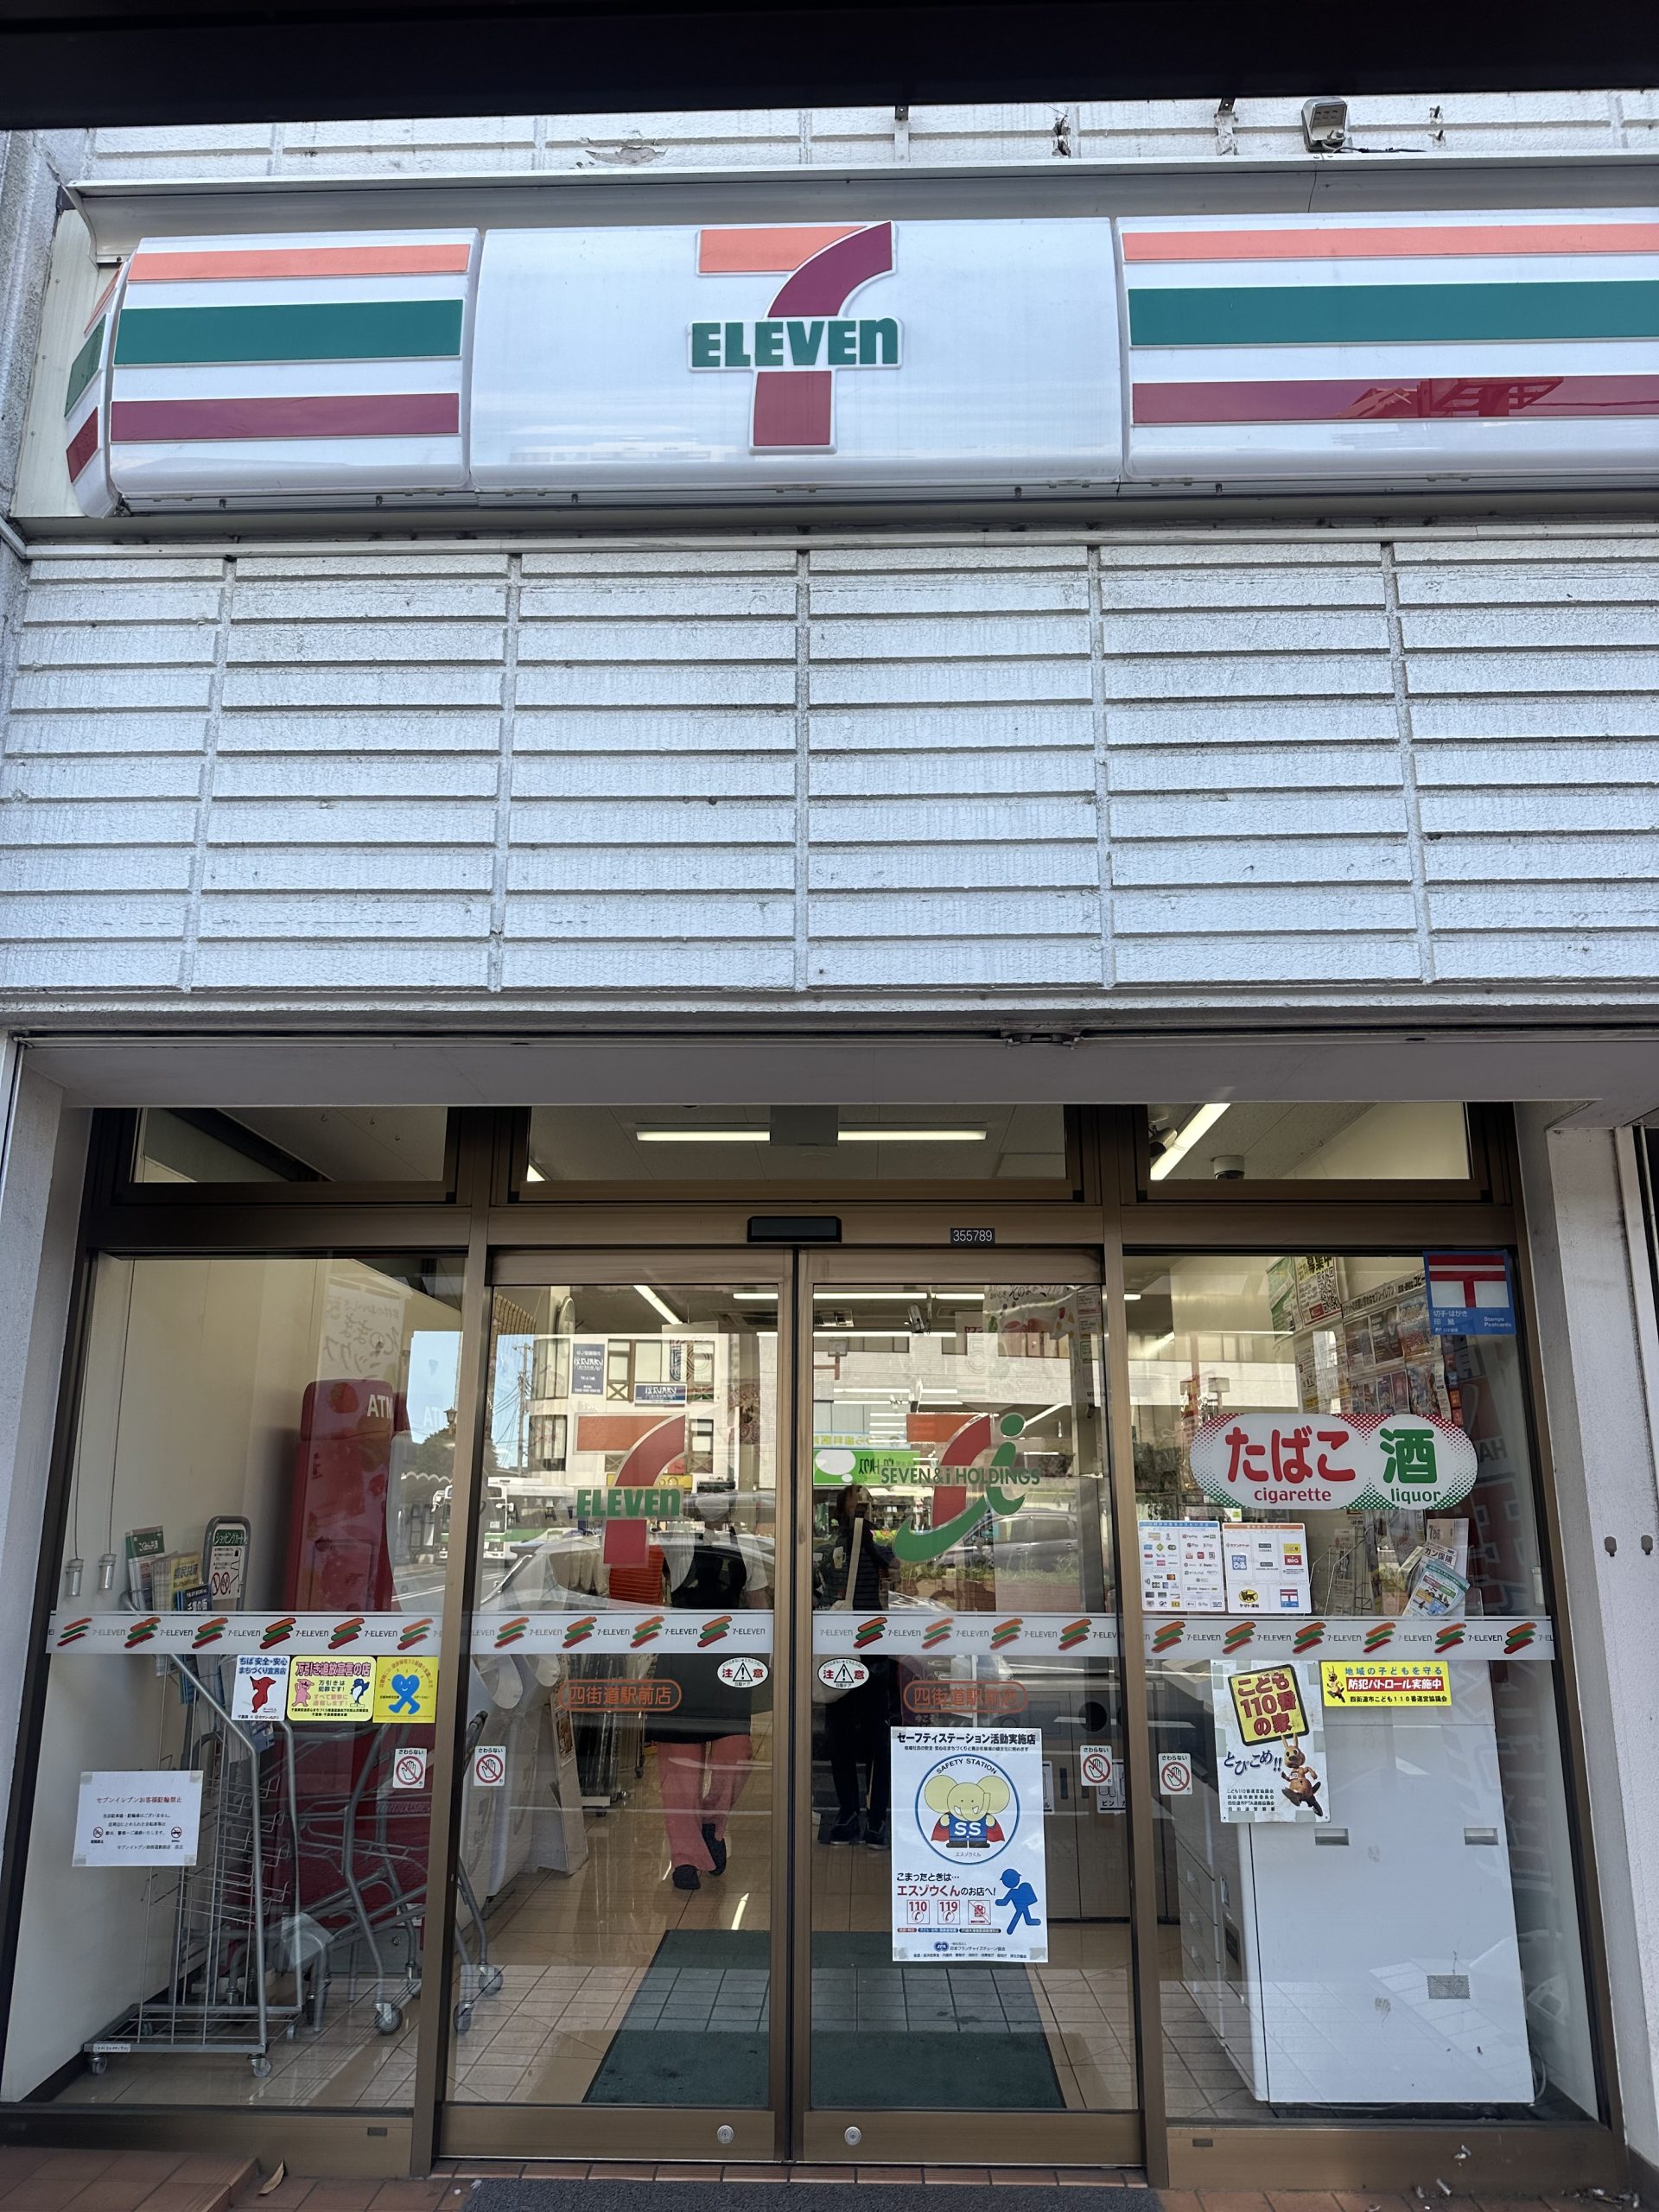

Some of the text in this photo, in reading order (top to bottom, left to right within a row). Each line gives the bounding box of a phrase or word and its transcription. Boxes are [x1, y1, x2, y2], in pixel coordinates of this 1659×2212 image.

[953, 1230, 993, 1243] 355789
[1225, 1425, 1438, 1484] たばこ 酒
[956, 1467, 1040, 1485] HOLDINGS
[1255, 1487, 1440, 1504] cigarette liquor
[296, 1662, 372, 1677] 万引き追放宣言の店
[1345, 1667, 1442, 1676] 地域の子どもを守る
[1237, 1673, 1290, 1697] こども
[1348, 1679, 1442, 1690] 防犯パトロール実施中
[569, 1686, 671, 1706] 四街道駅前店
[1240, 1690, 1297, 1719] 110番
[1254, 1713, 1293, 1737] の家
[897, 1732, 1036, 1745] セーフティステーション活動実施店
[936, 1758, 997, 1775] SAFETY STATION
[954, 1821, 982, 1836] SS
[909, 1901, 958, 1912] 110 119
